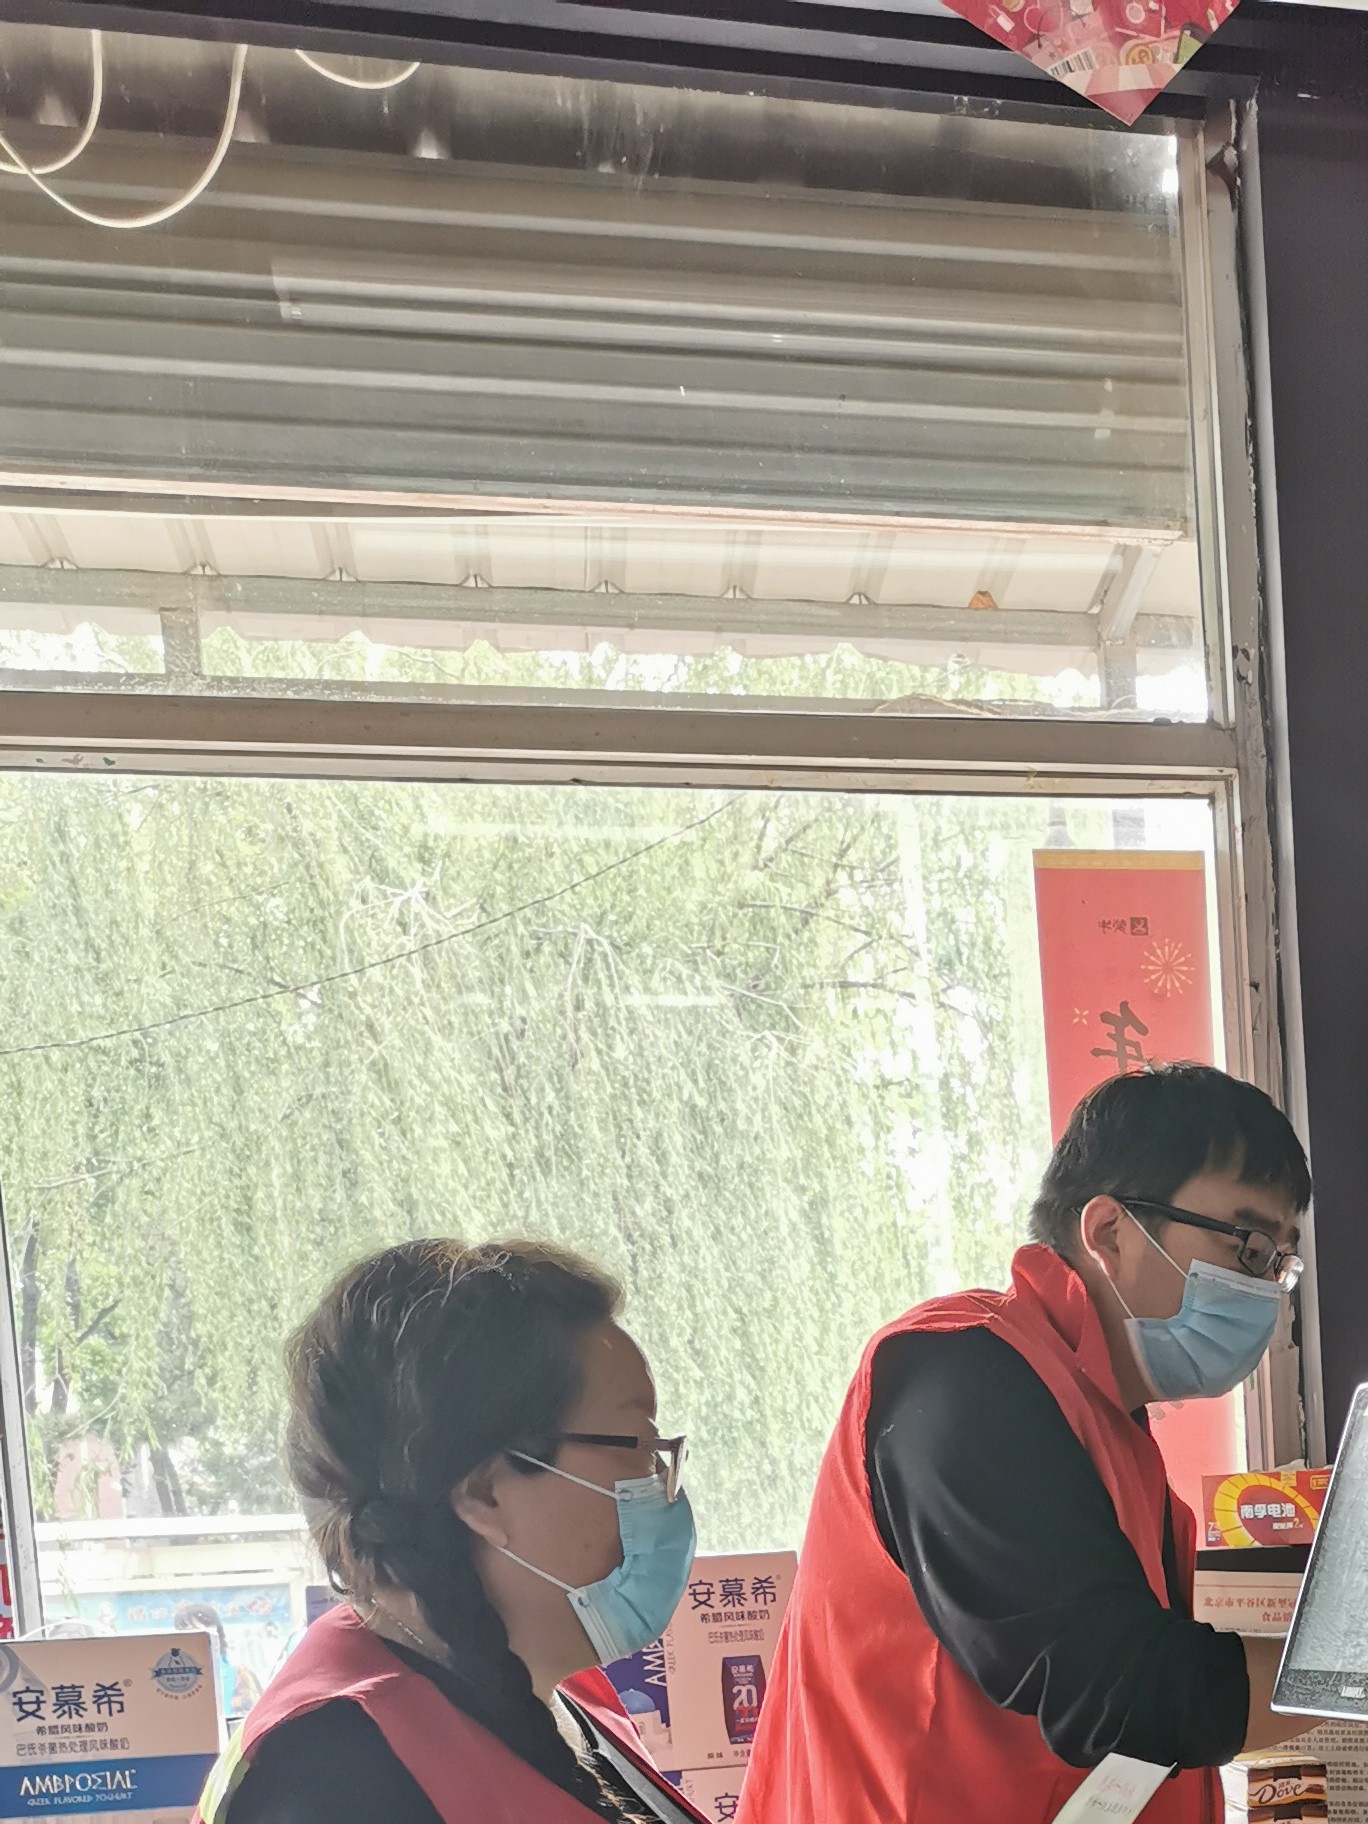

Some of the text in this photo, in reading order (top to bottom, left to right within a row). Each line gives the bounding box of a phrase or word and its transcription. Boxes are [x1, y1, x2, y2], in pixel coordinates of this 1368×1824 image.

[1240, 1502, 1296, 1519] 南孚电池
[687, 1576, 777, 1610] 安慕希
[700, 1609, 771, 1624] 希腊风味酸奶
[12, 1681, 125, 1722] 安慕希
[36, 1722, 109, 1736] 希腊风味酸奶
[1250, 1782, 1304, 1804] Dove
